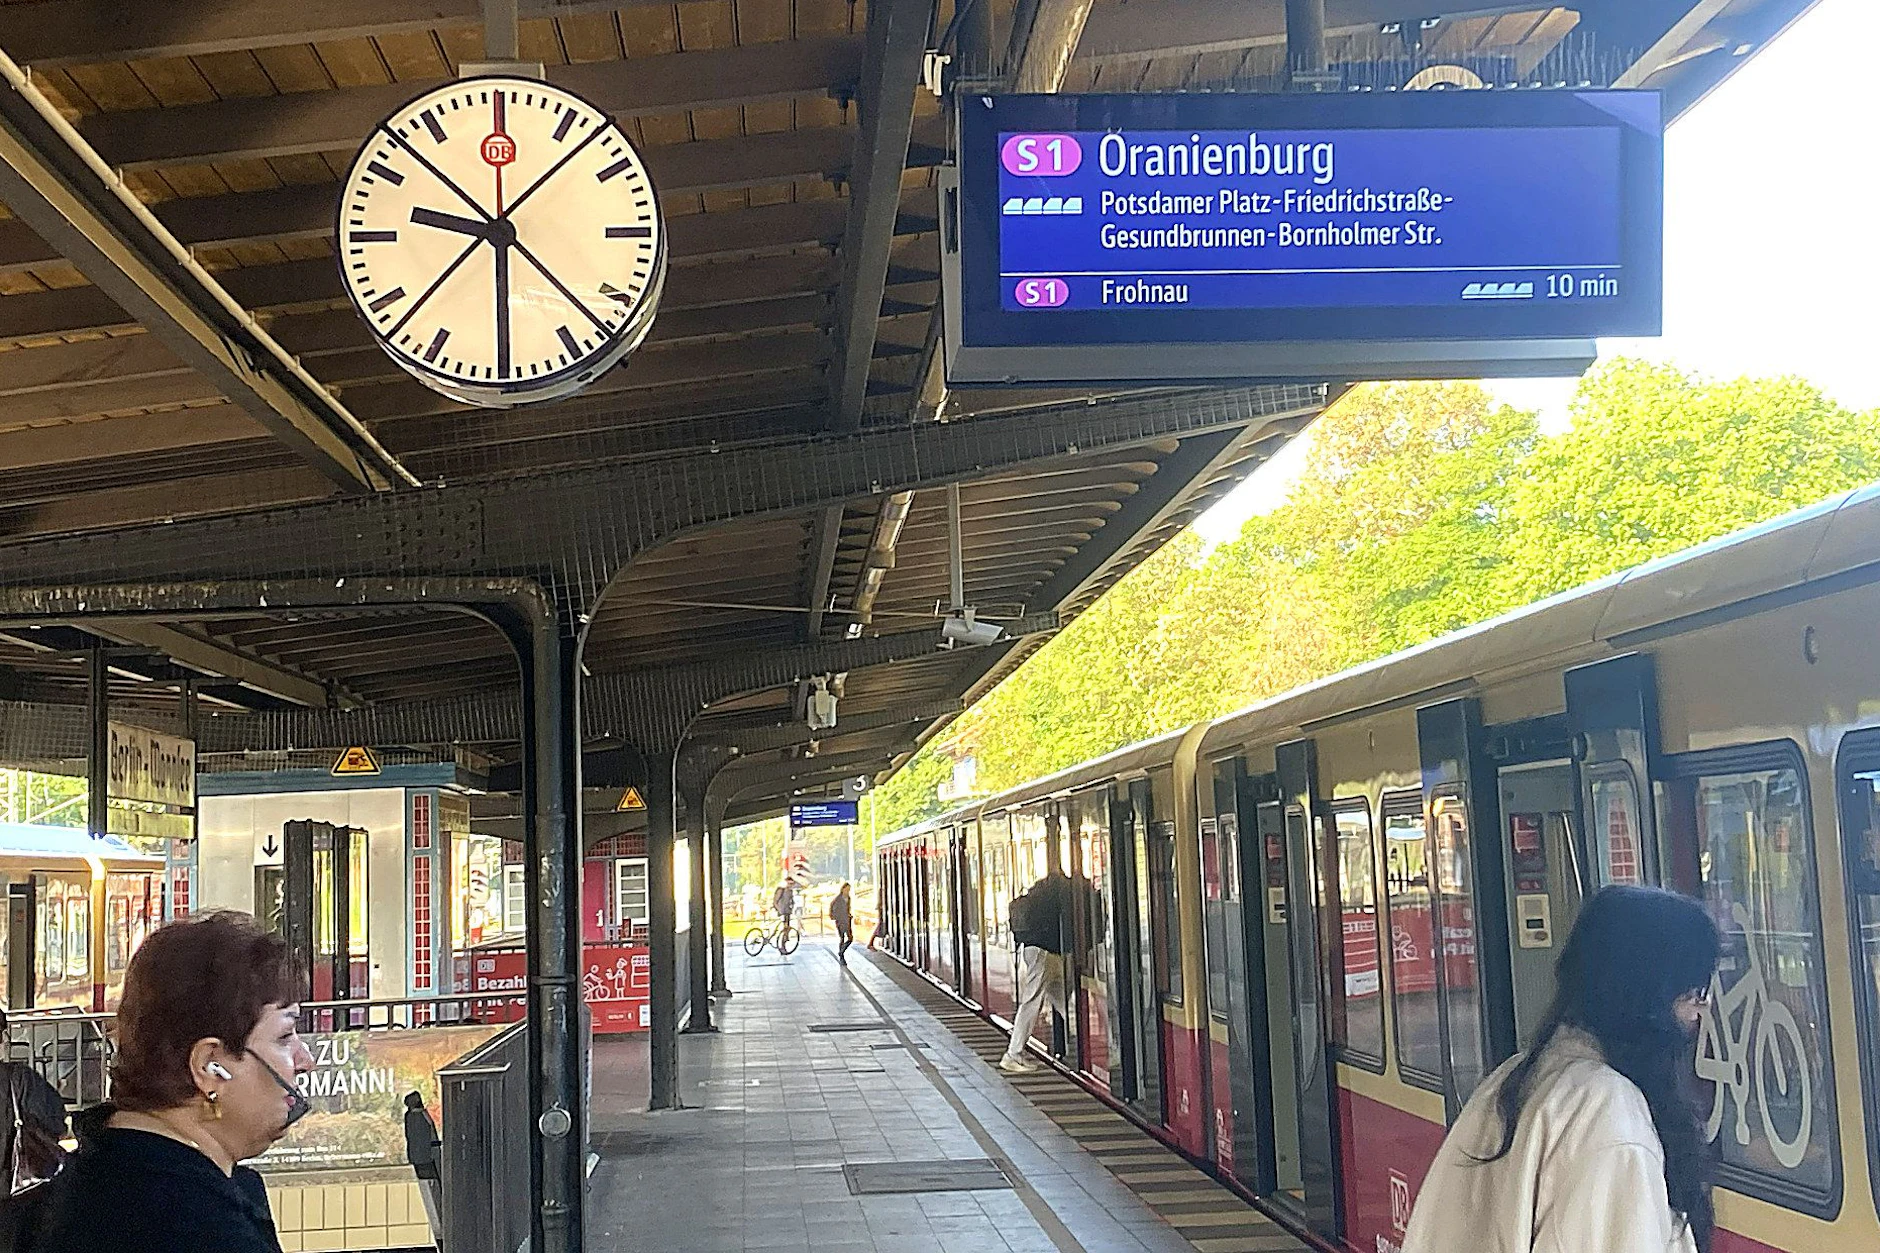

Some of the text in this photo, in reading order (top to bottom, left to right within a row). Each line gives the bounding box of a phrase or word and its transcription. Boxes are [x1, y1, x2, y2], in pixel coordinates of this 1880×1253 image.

[488, 146, 511, 160] DB
[1100, 133, 1335, 185] Oranienburg
[1101, 190, 1214, 215] Potsdamer
[1404, 220, 1442, 246] Str.
[1102, 273, 1618, 304] Frohnau 10 min
[316, 1039, 350, 1066] ZU
